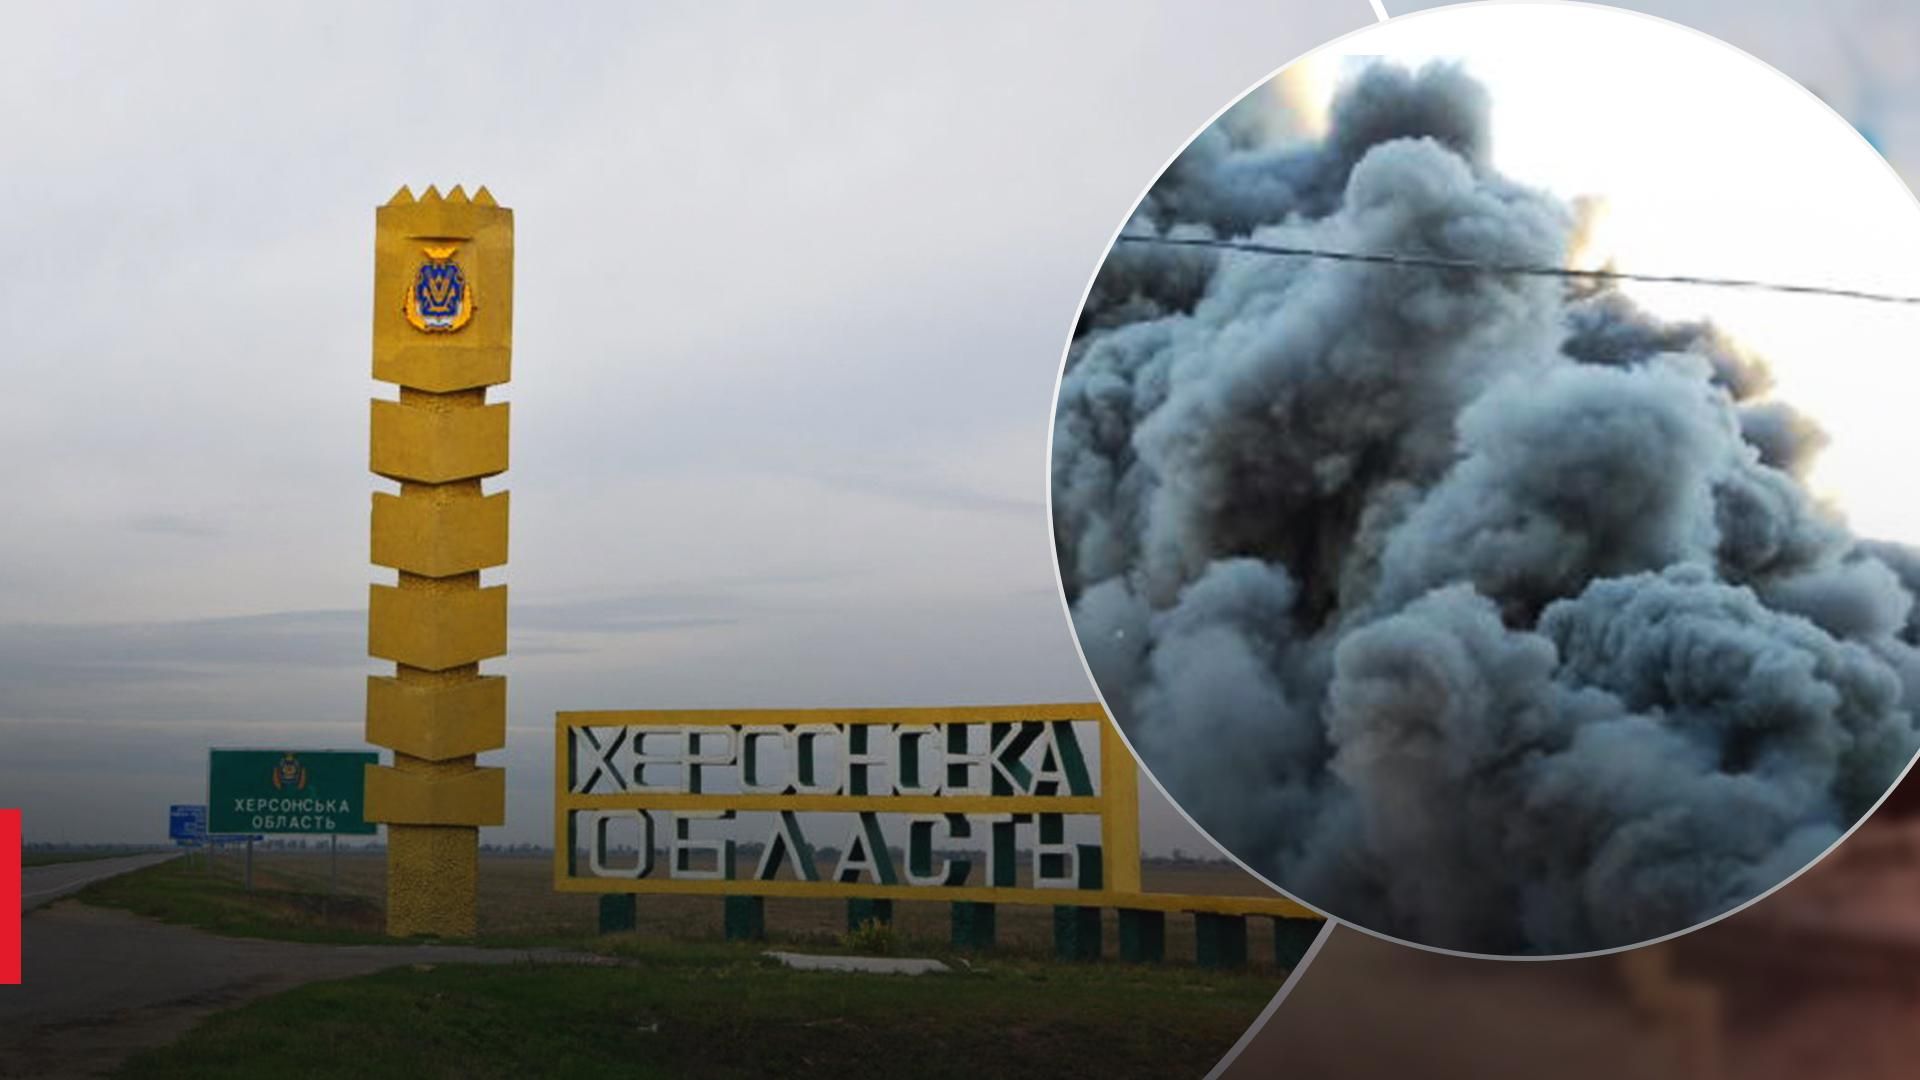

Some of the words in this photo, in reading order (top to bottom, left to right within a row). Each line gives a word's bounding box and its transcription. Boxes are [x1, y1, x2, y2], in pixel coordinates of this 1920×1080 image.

[570, 720, 1090, 797] ХЕРСОНСЬКА
[234, 798, 350, 812] ХЕРСОНСЬКА
[251, 815, 337, 829] ОБЛАСТЬ
[589, 809, 1087, 888] ОБЛАСТЬ
